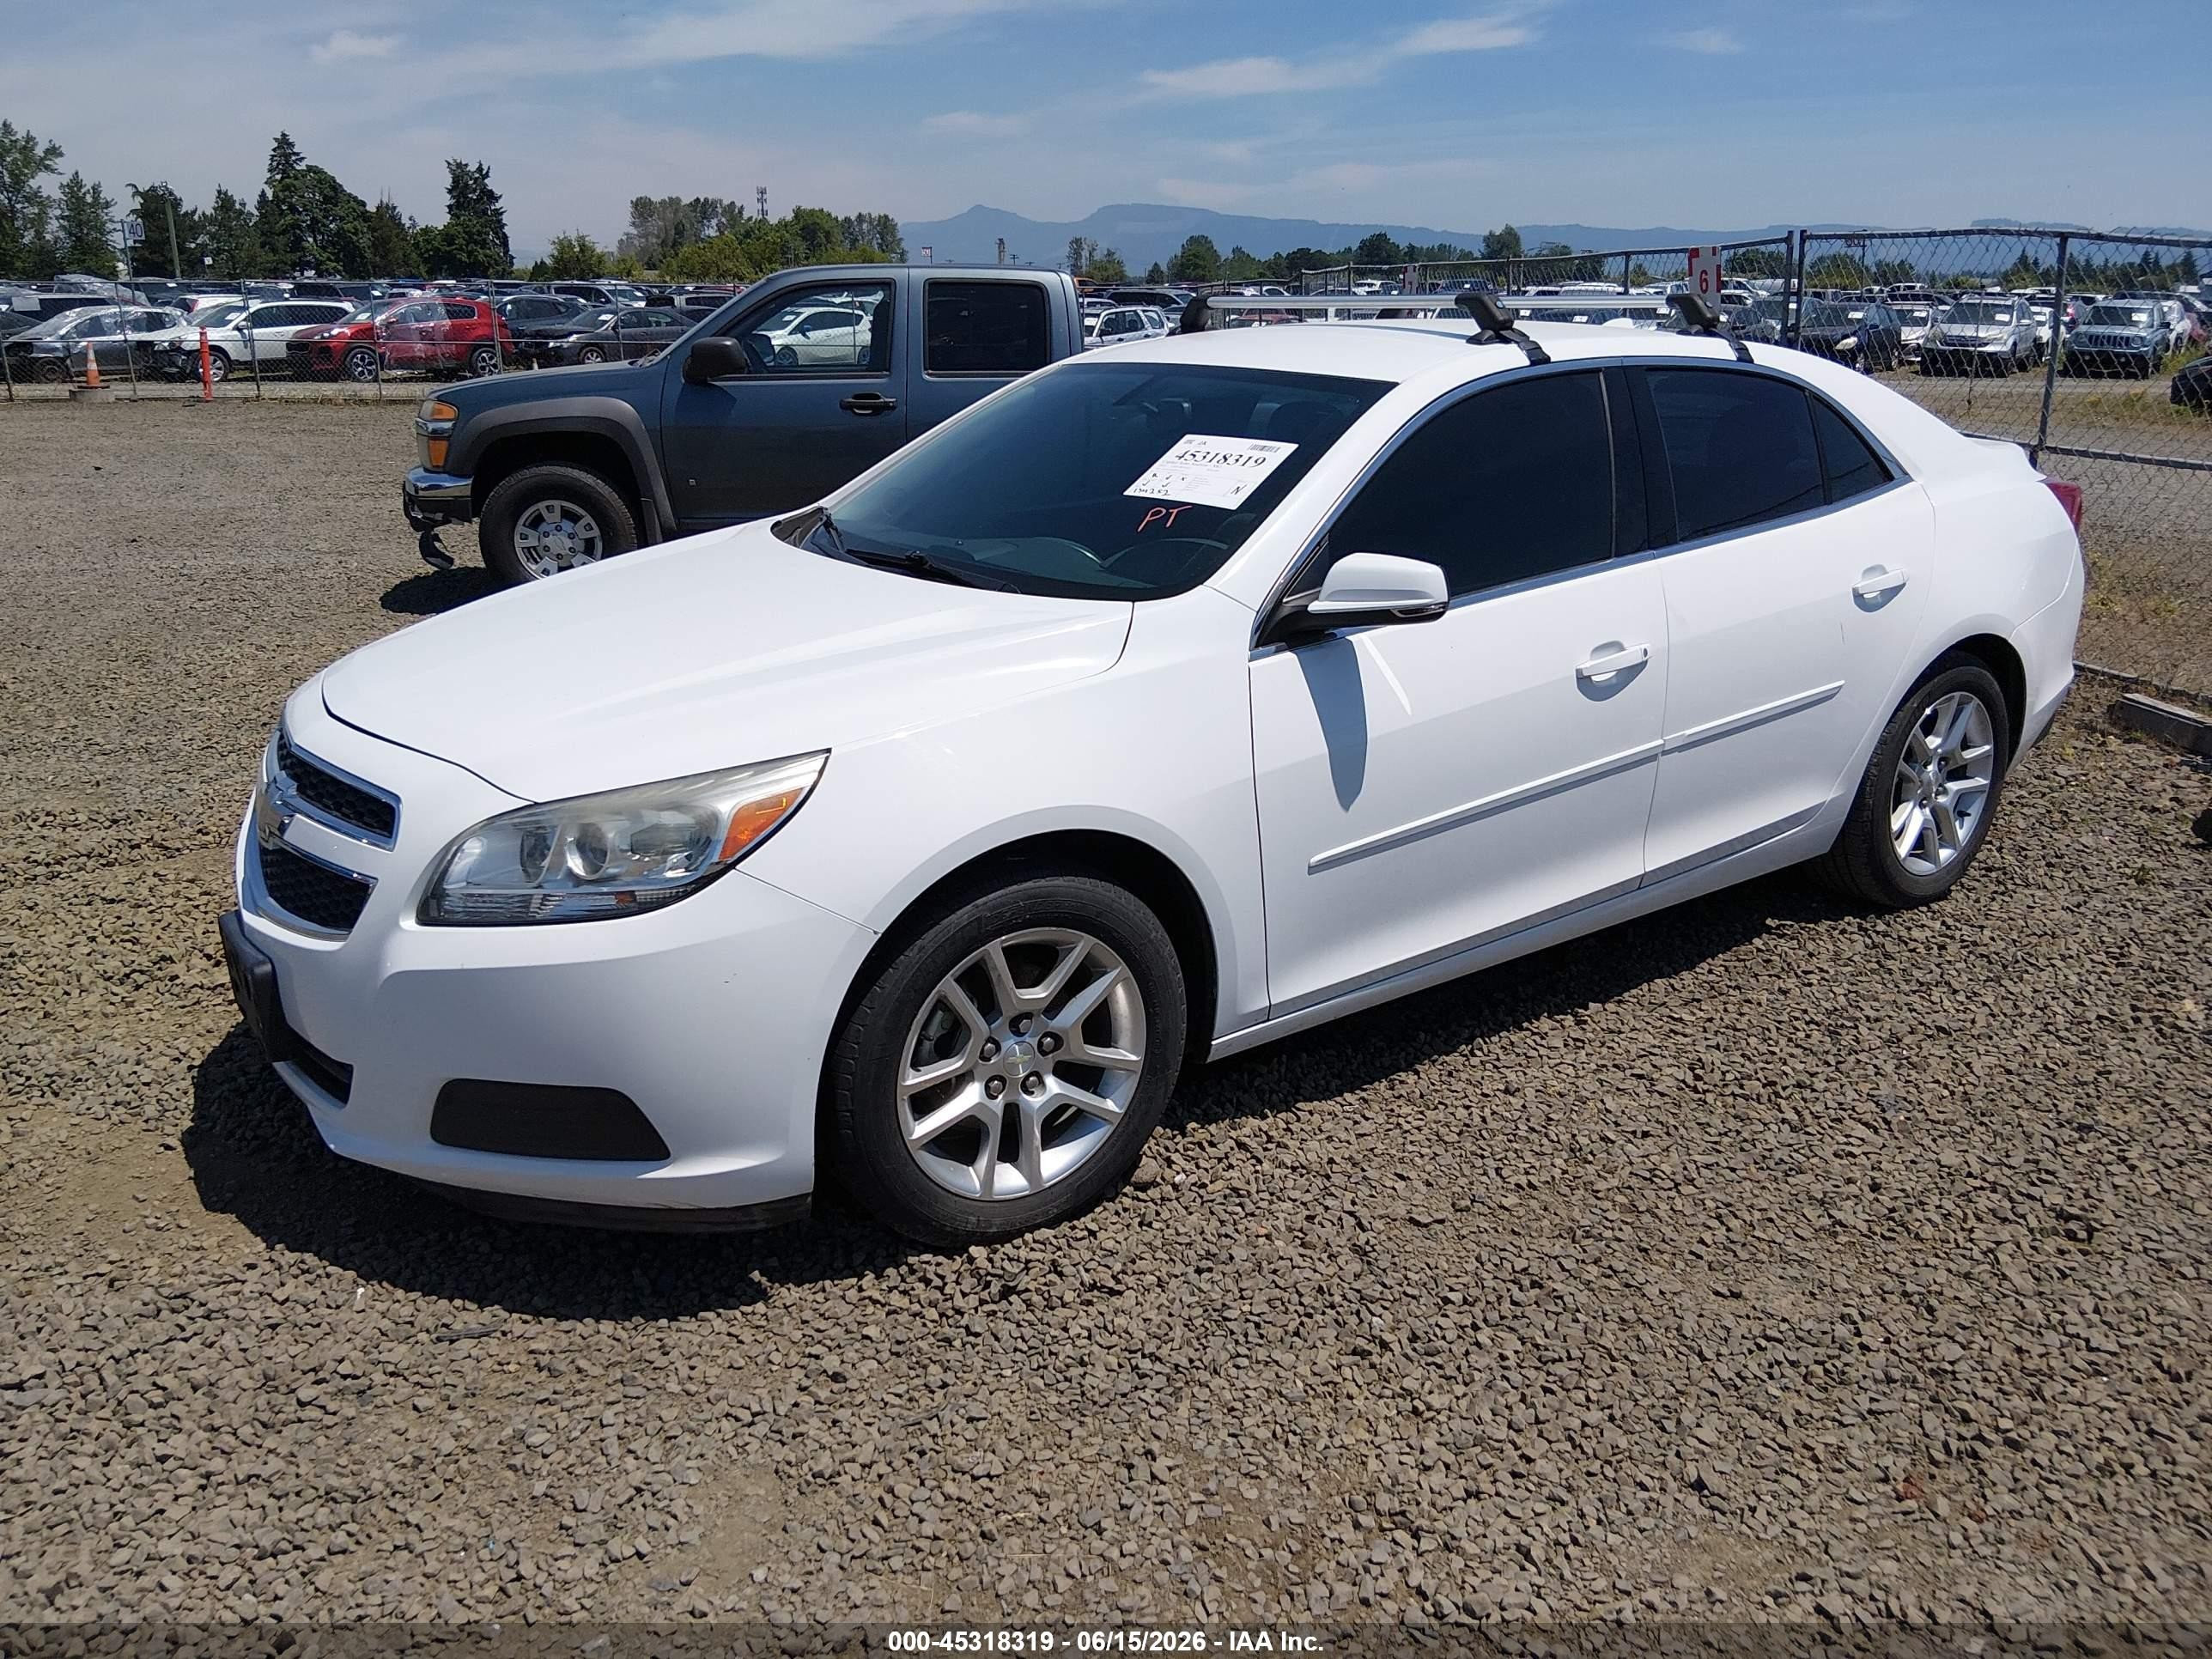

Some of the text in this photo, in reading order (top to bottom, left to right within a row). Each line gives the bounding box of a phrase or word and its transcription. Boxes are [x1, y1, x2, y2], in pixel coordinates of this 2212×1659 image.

[129, 223, 143, 238] 40
[1699, 269, 1709, 295] 6
[1175, 449, 1267, 468] 45318319
[1137, 505, 1194, 533] PT
